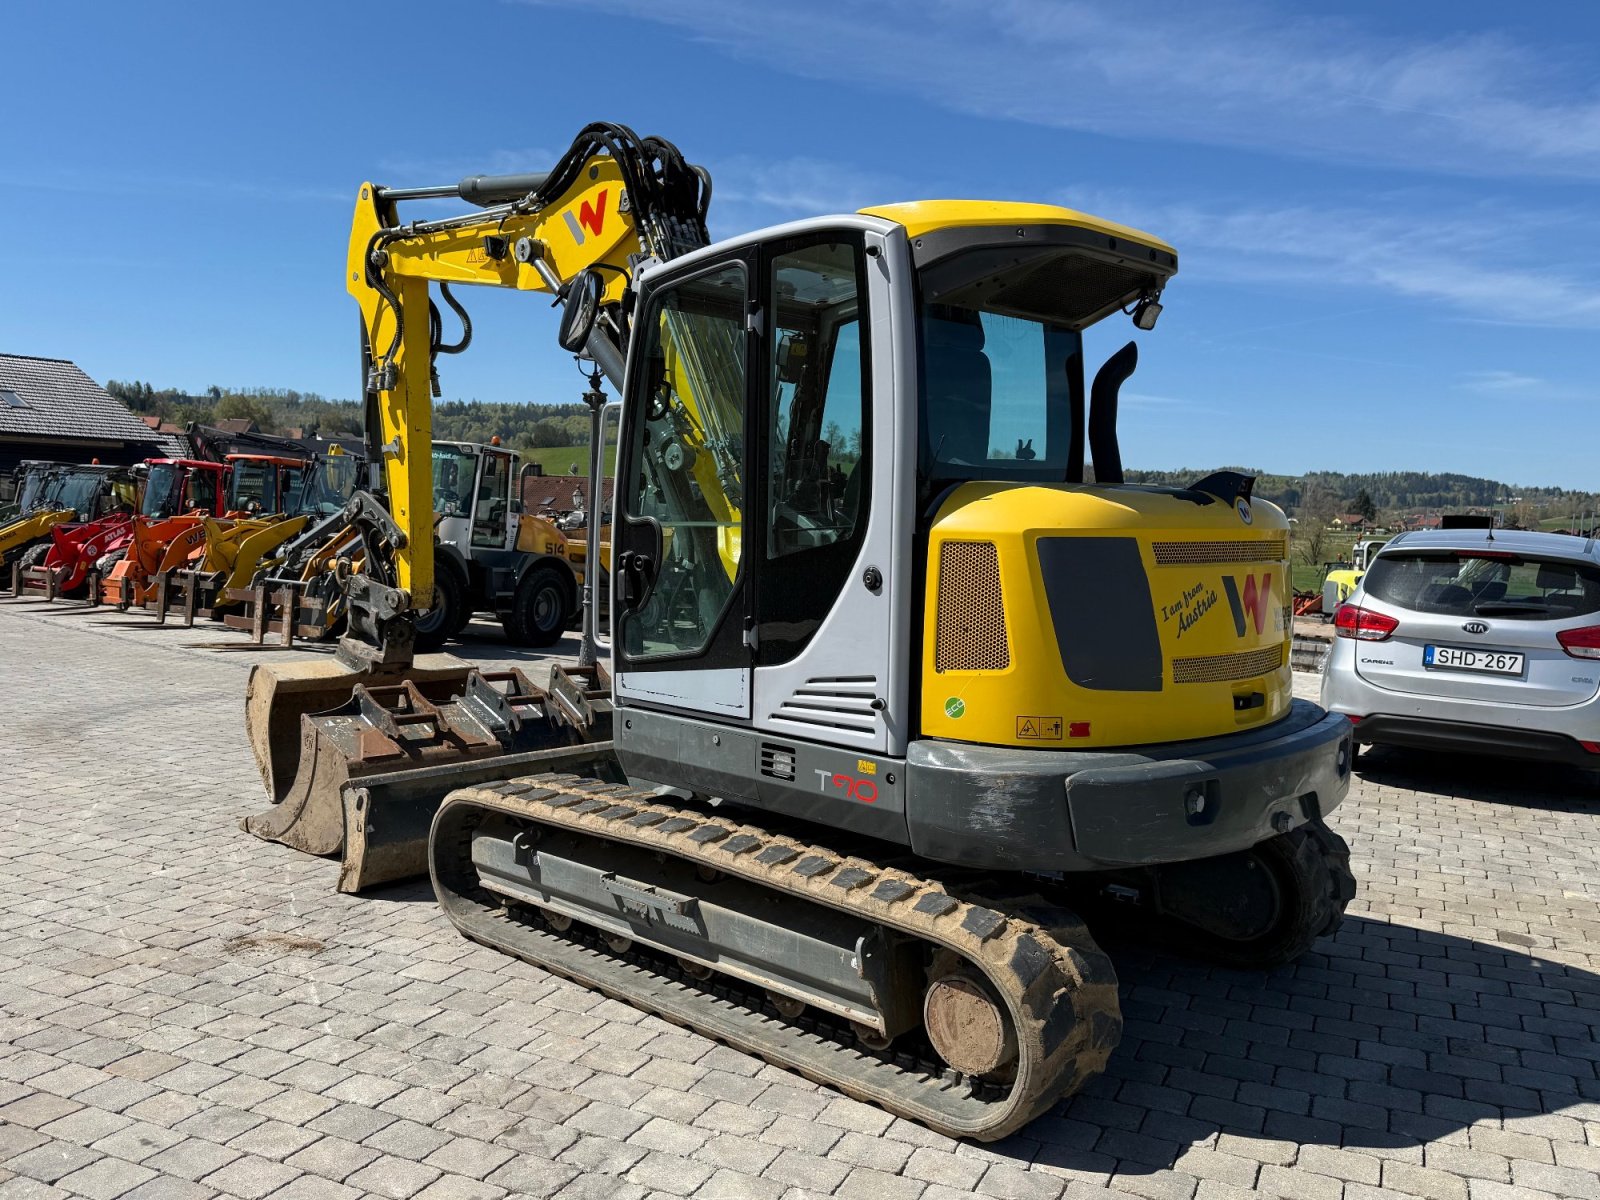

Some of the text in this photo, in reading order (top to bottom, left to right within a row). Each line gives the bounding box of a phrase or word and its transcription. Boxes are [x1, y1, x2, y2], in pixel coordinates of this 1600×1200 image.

[104, 527, 126, 543] ATLAS
[1161, 581, 1204, 622] I am from
[1176, 589, 1219, 639] Austria
[1466, 623, 1485, 633] KIA
[1361, 657, 1394, 666] CARENS
[1437, 649, 1519, 671] SHD-267
[814, 768, 879, 804] T90
